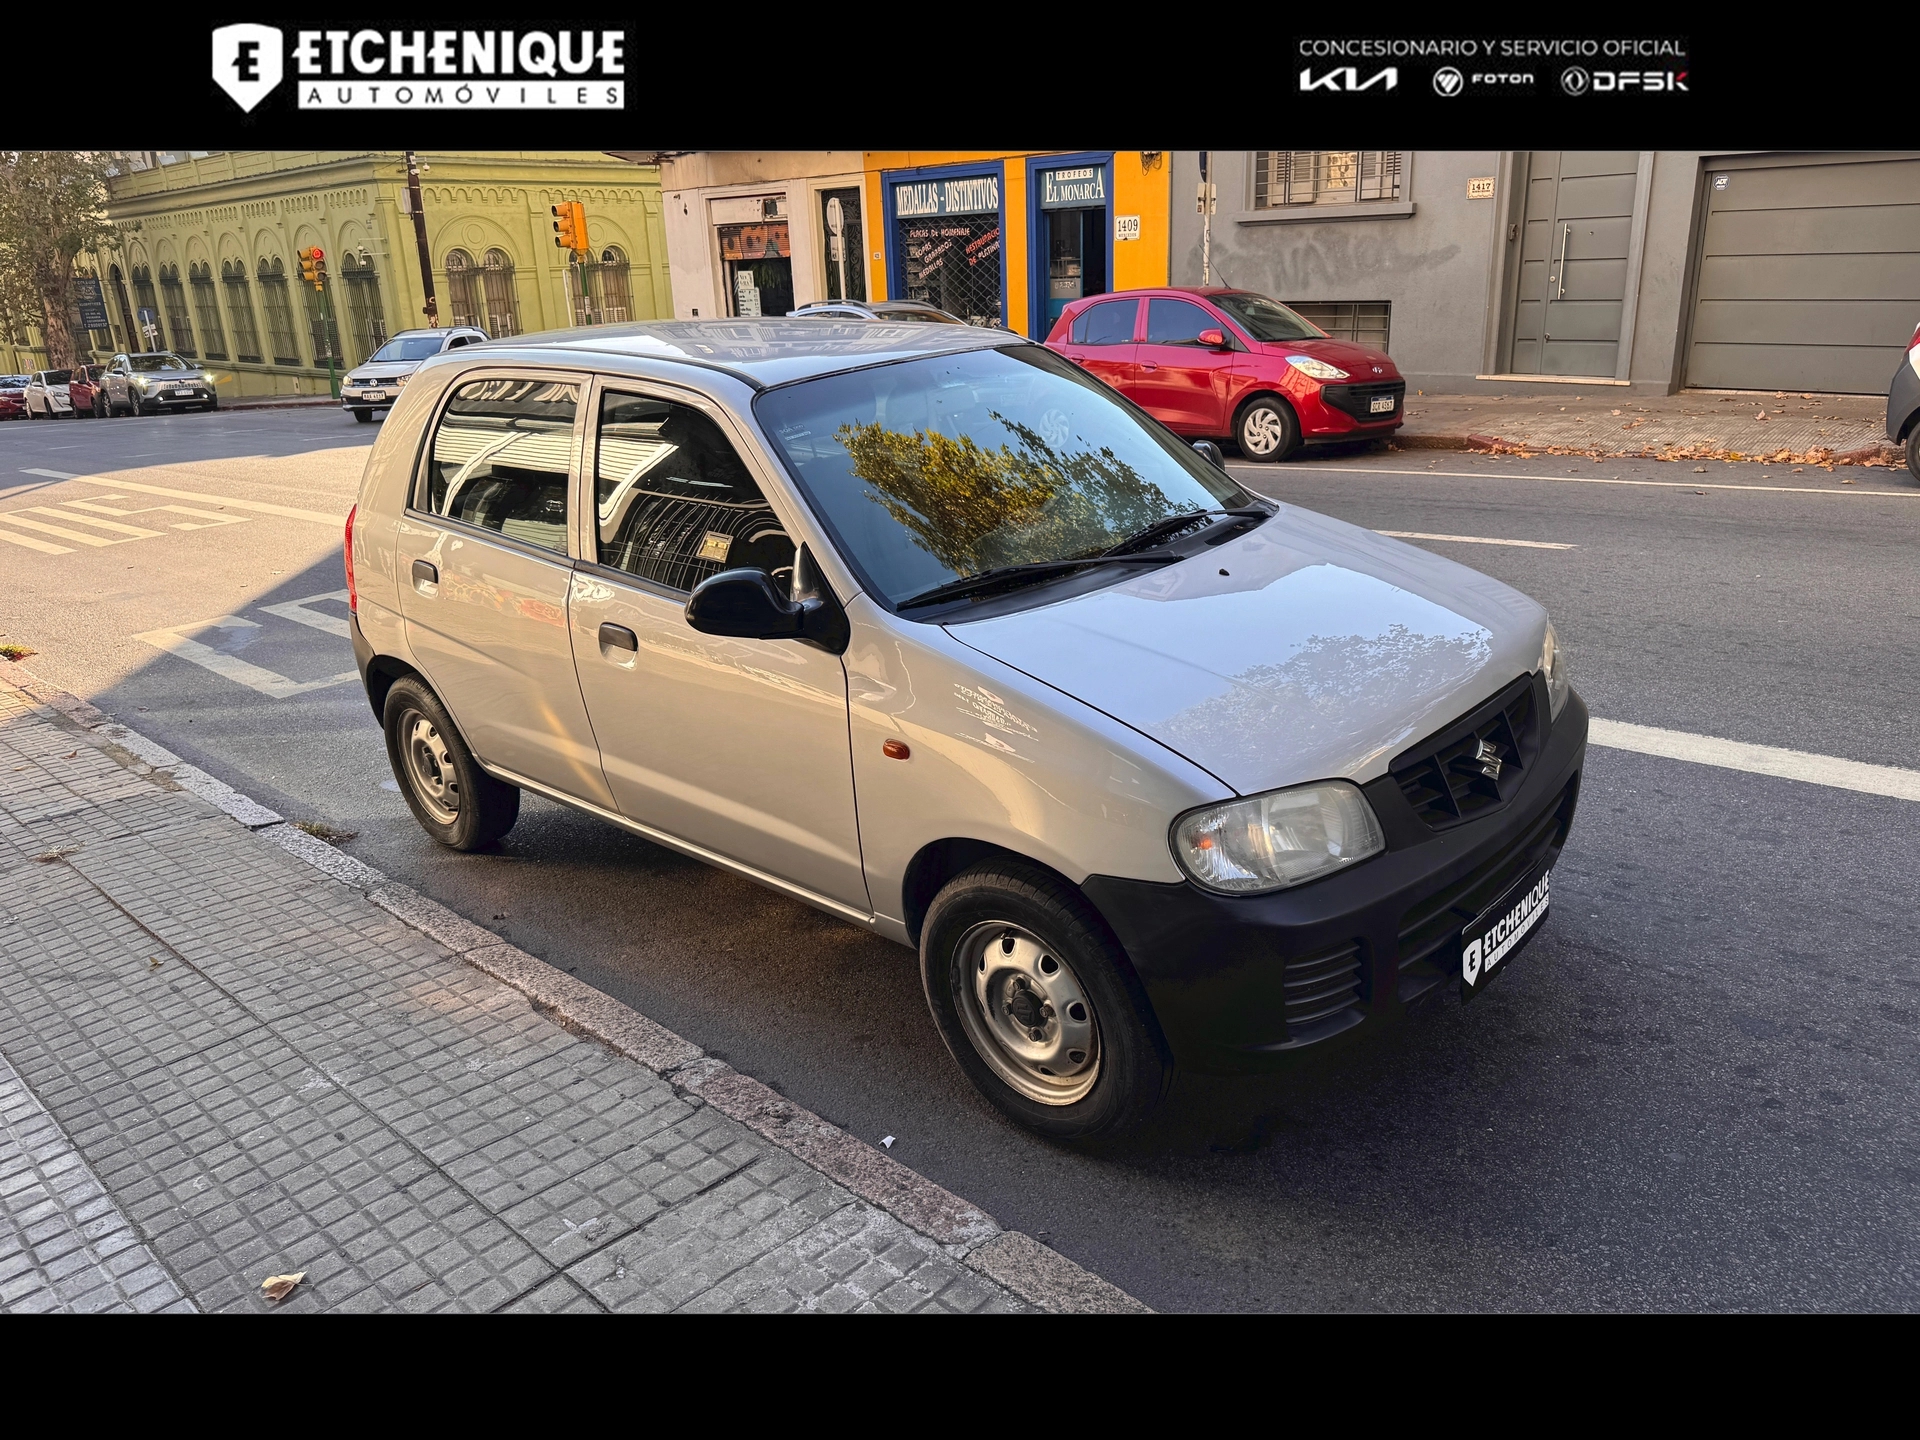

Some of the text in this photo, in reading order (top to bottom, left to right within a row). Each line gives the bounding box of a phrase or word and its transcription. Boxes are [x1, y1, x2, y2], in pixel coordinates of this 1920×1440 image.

[1057, 169, 1092, 179] TROFEOS
[1060, 167, 1105, 202] MONARCA
[1472, 182, 1491, 190] 1417
[896, 182, 939, 216] MEDALLAS
[944, 177, 999, 213] DISTINTIVOS
[1117, 219, 1138, 232] 1409
[910, 229, 929, 238] PLACAS
[940, 227, 970, 237] HOMENAJE
[1483, 869, 1549, 956] ETCHENIQUE
